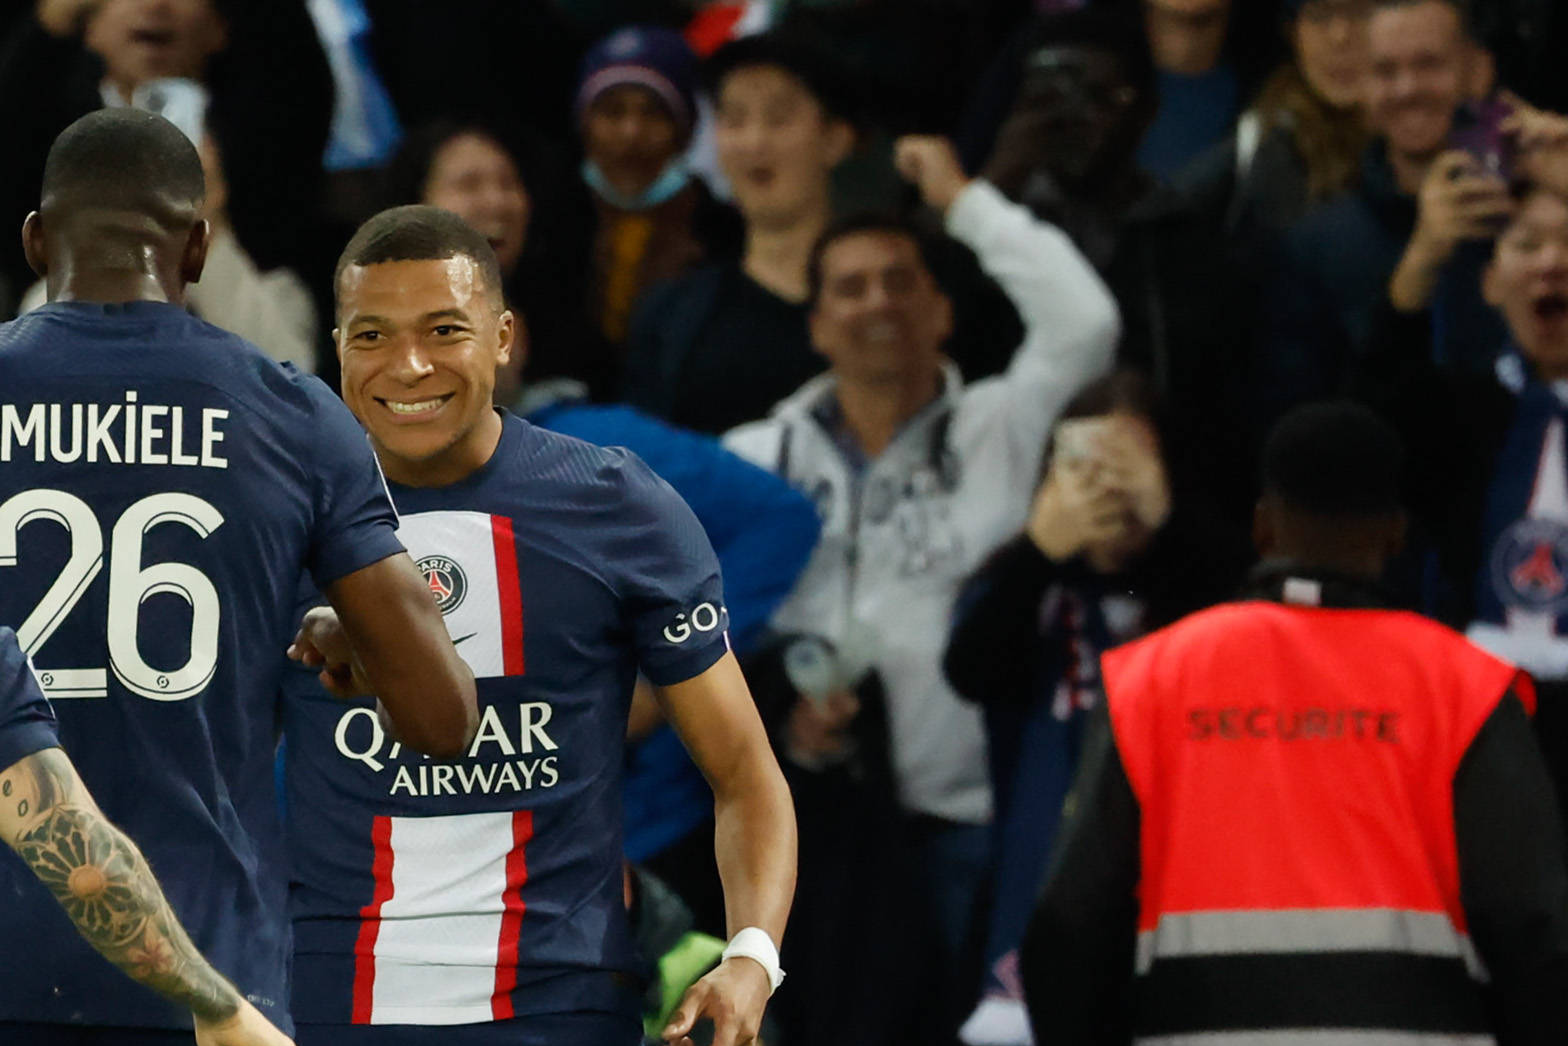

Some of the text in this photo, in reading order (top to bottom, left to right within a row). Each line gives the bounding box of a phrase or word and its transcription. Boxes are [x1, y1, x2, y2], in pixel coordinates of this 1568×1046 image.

[417, 560, 453, 573] ARIS
[664, 602, 727, 643] GO
[334, 702, 559, 772] QAR
[389, 756, 559, 796] AIRWAYS
